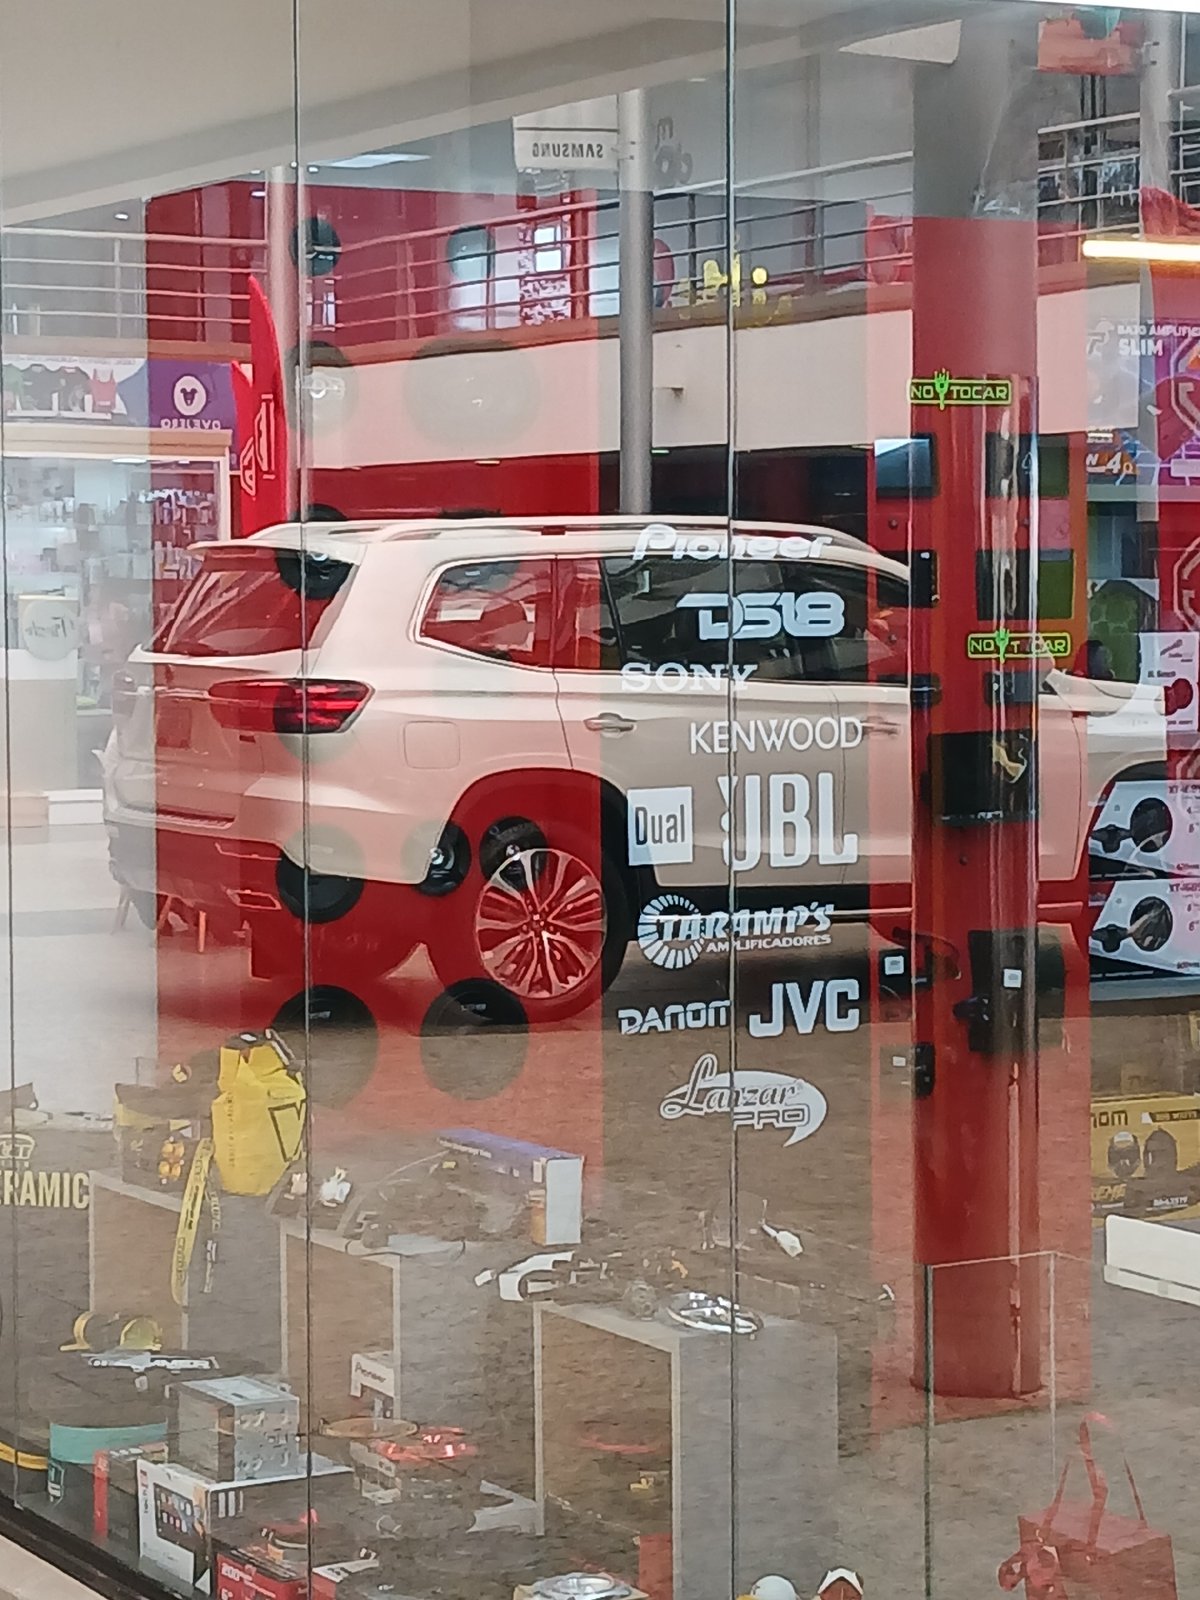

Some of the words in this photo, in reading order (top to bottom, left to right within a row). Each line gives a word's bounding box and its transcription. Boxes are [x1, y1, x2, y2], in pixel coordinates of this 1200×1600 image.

[1118, 338, 1164, 357] SLIM
[911, 386, 935, 398] NO
[950, 386, 1007, 399] TOCAR
[632, 523, 833, 560] Pioneer
[676, 591, 845, 640] DS18
[970, 639, 995, 653] NO
[620, 662, 758, 693] SONY
[690, 716, 864, 754] KENWOOD
[635, 804, 685, 846] Dual
[721, 772, 858, 872] JBL
[706, 934, 832, 953] AMPLIFICADORES
[748, 979, 860, 1038] JVC
[660, 1053, 798, 1120] Lanzar
[732, 1107, 807, 1128] PRO
[0, 1170, 89, 1209] RAMIC
